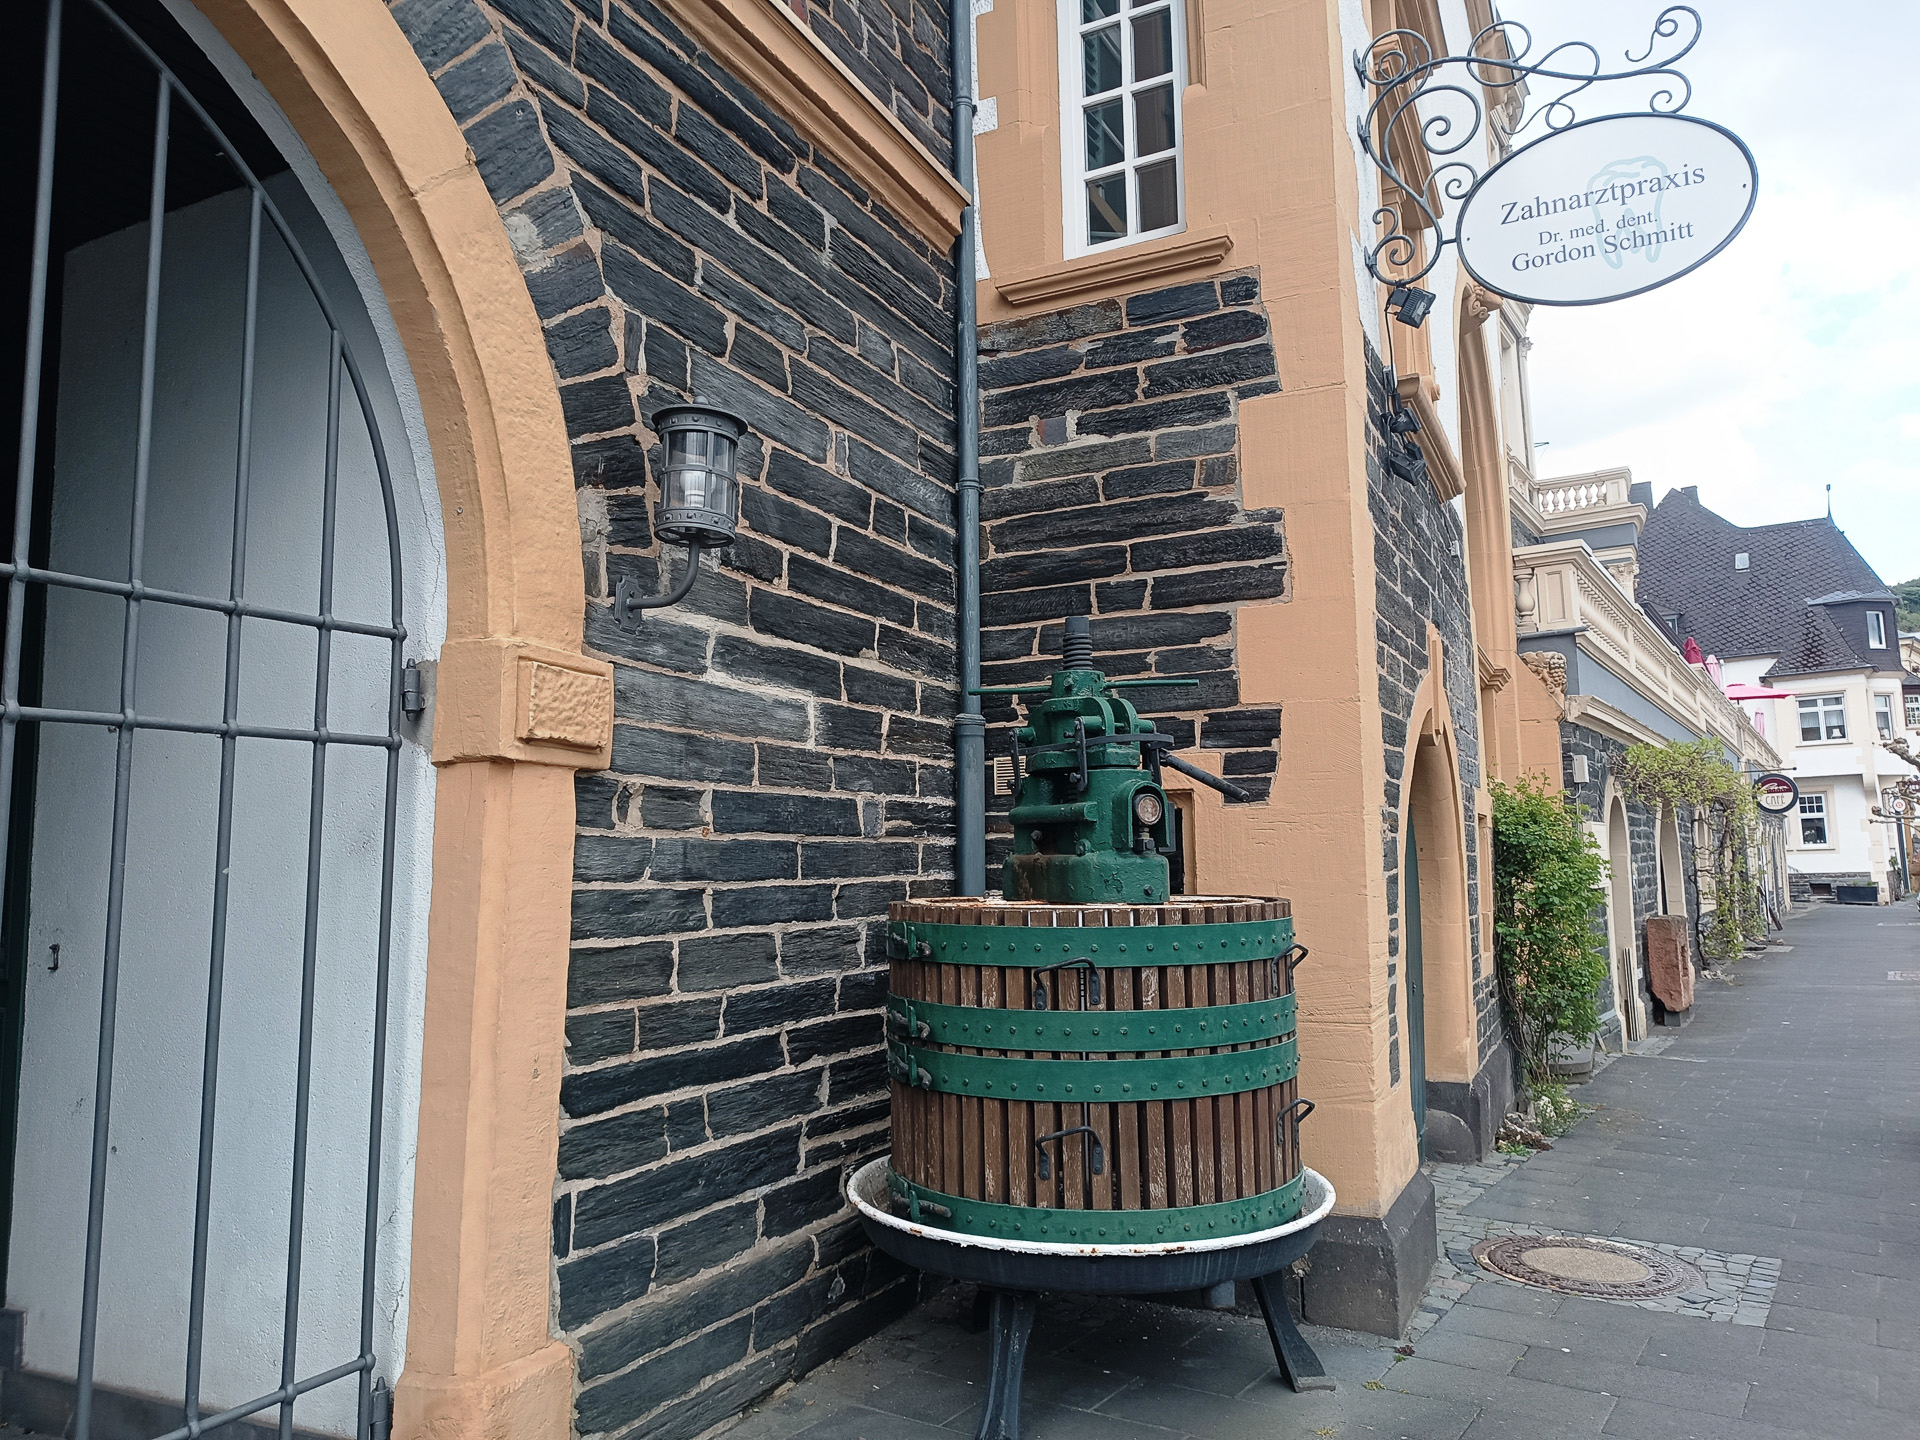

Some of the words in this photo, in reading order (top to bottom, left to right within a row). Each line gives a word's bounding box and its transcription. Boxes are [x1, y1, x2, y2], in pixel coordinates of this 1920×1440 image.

[1500, 163, 1706, 226] Zahnarztpraxis
[1511, 243, 1596, 272] Gordon
[1603, 221, 1695, 254] Schmitt
[1538, 231, 1564, 246] Dr.
[1569, 219, 1610, 240] med.
[1616, 211, 1658, 230] dent.
